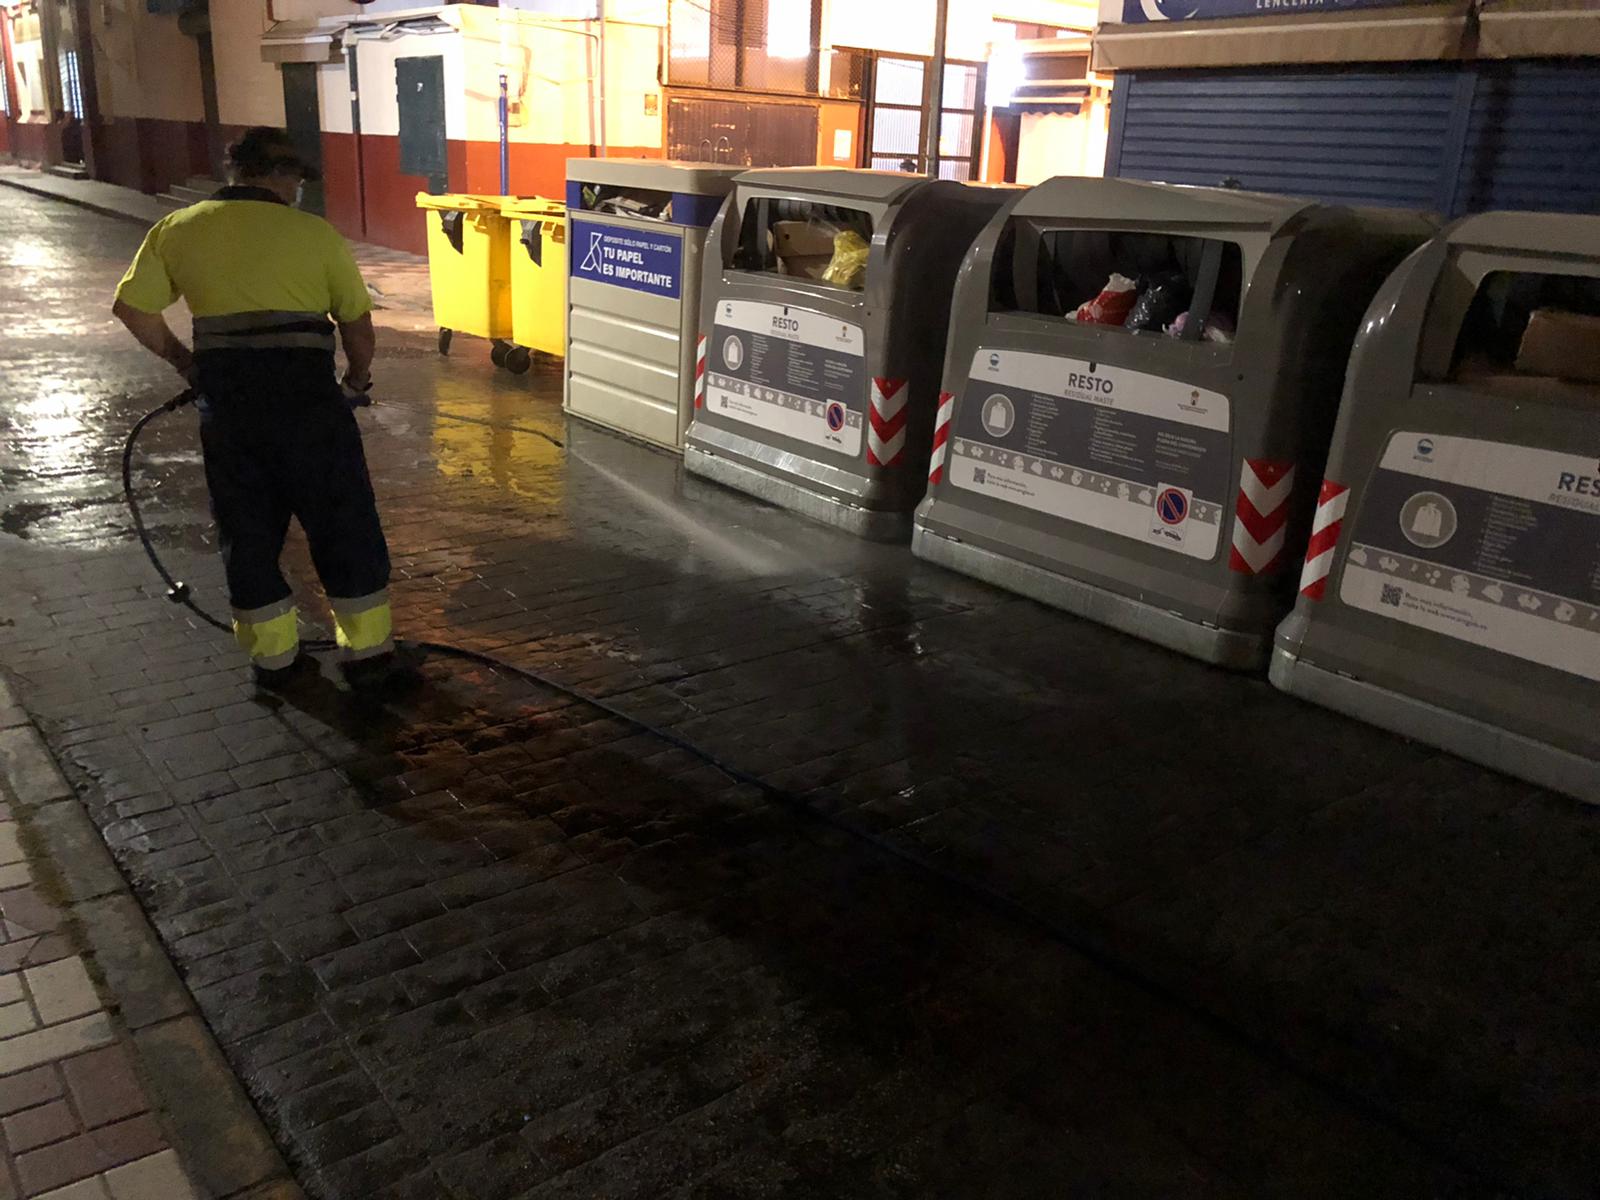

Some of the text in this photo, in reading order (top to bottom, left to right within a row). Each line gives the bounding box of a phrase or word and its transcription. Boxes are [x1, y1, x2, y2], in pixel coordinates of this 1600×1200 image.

[603, 246, 644, 265] TU PAPEL
[603, 263, 672, 288] ES IMPORTANTE
[772, 315, 799, 332] RESTO
[1068, 372, 1113, 394] RESTO
